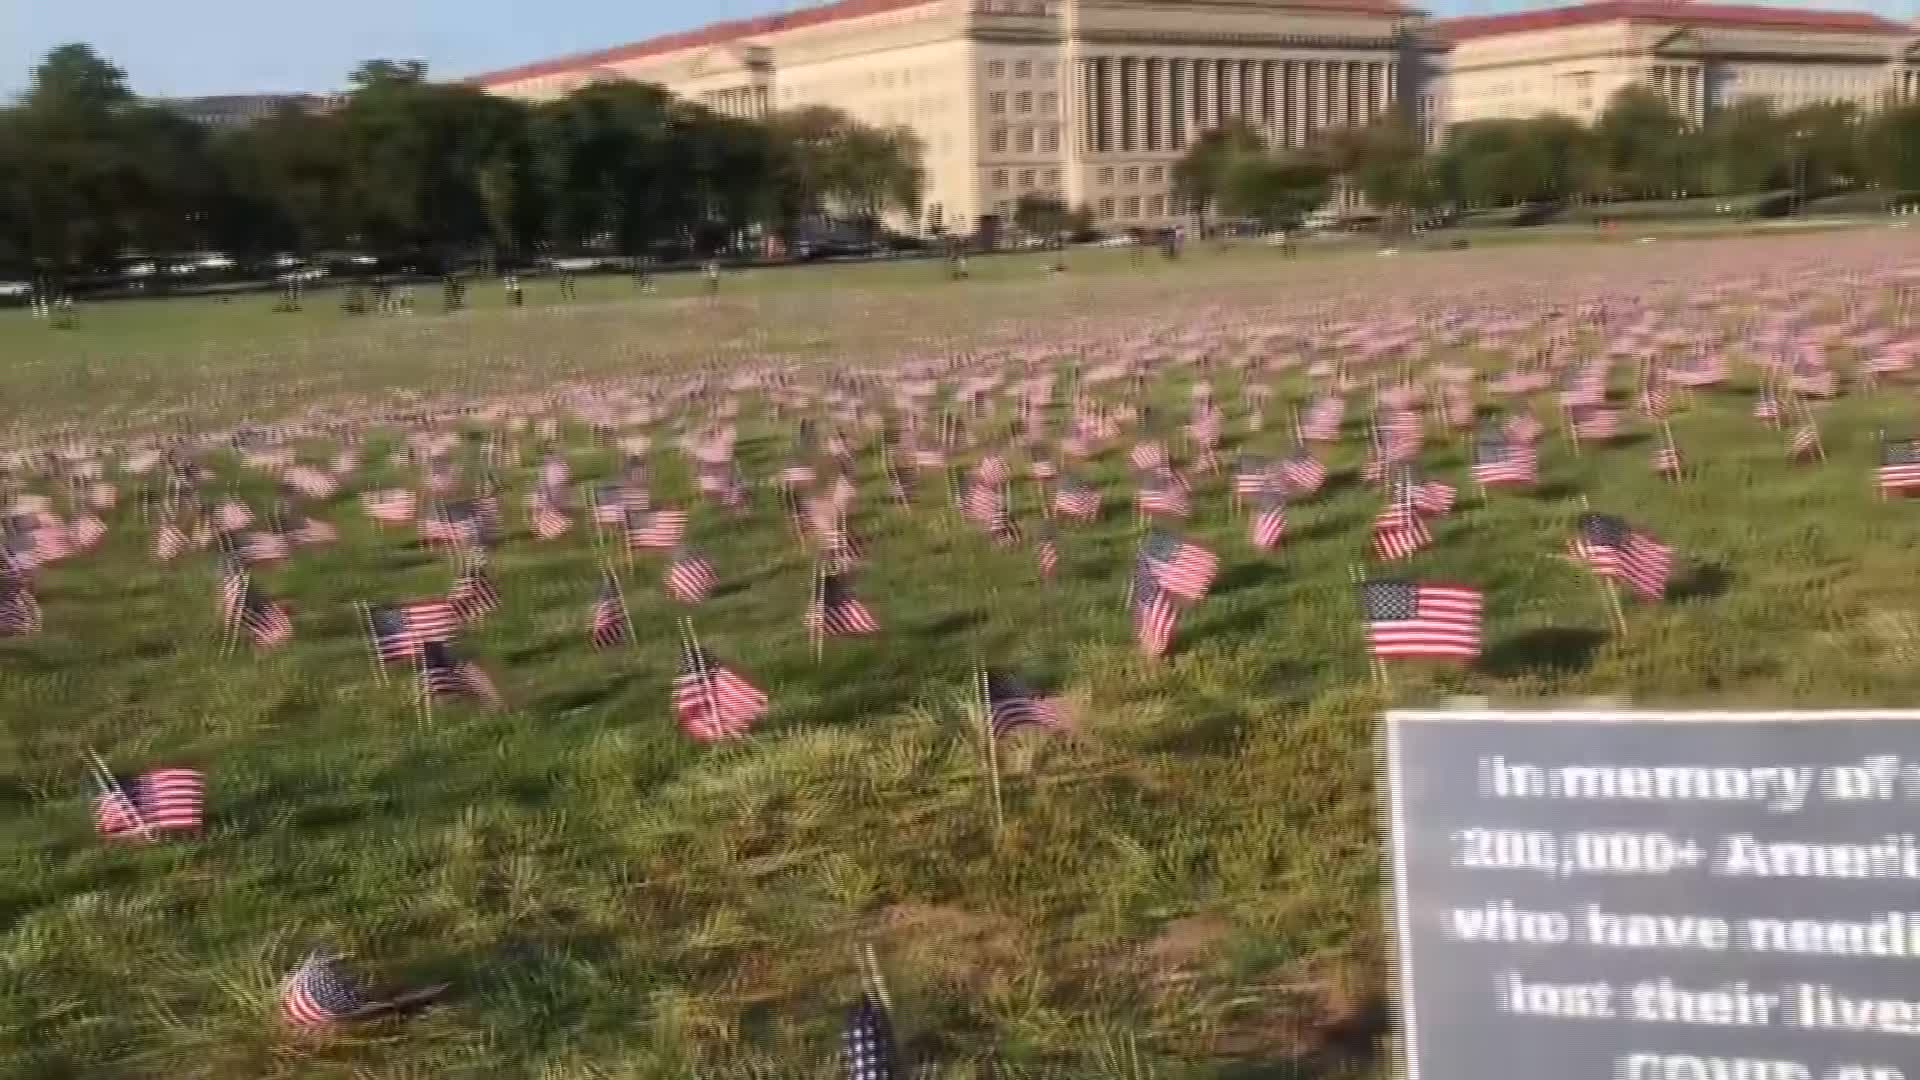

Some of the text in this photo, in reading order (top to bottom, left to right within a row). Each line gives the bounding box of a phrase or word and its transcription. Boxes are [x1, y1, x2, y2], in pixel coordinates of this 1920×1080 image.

[1548, 766, 1815, 813] memory
[1819, 755, 1901, 801] of
[1579, 904, 1731, 950] have
[1624, 977, 1780, 1025] their
